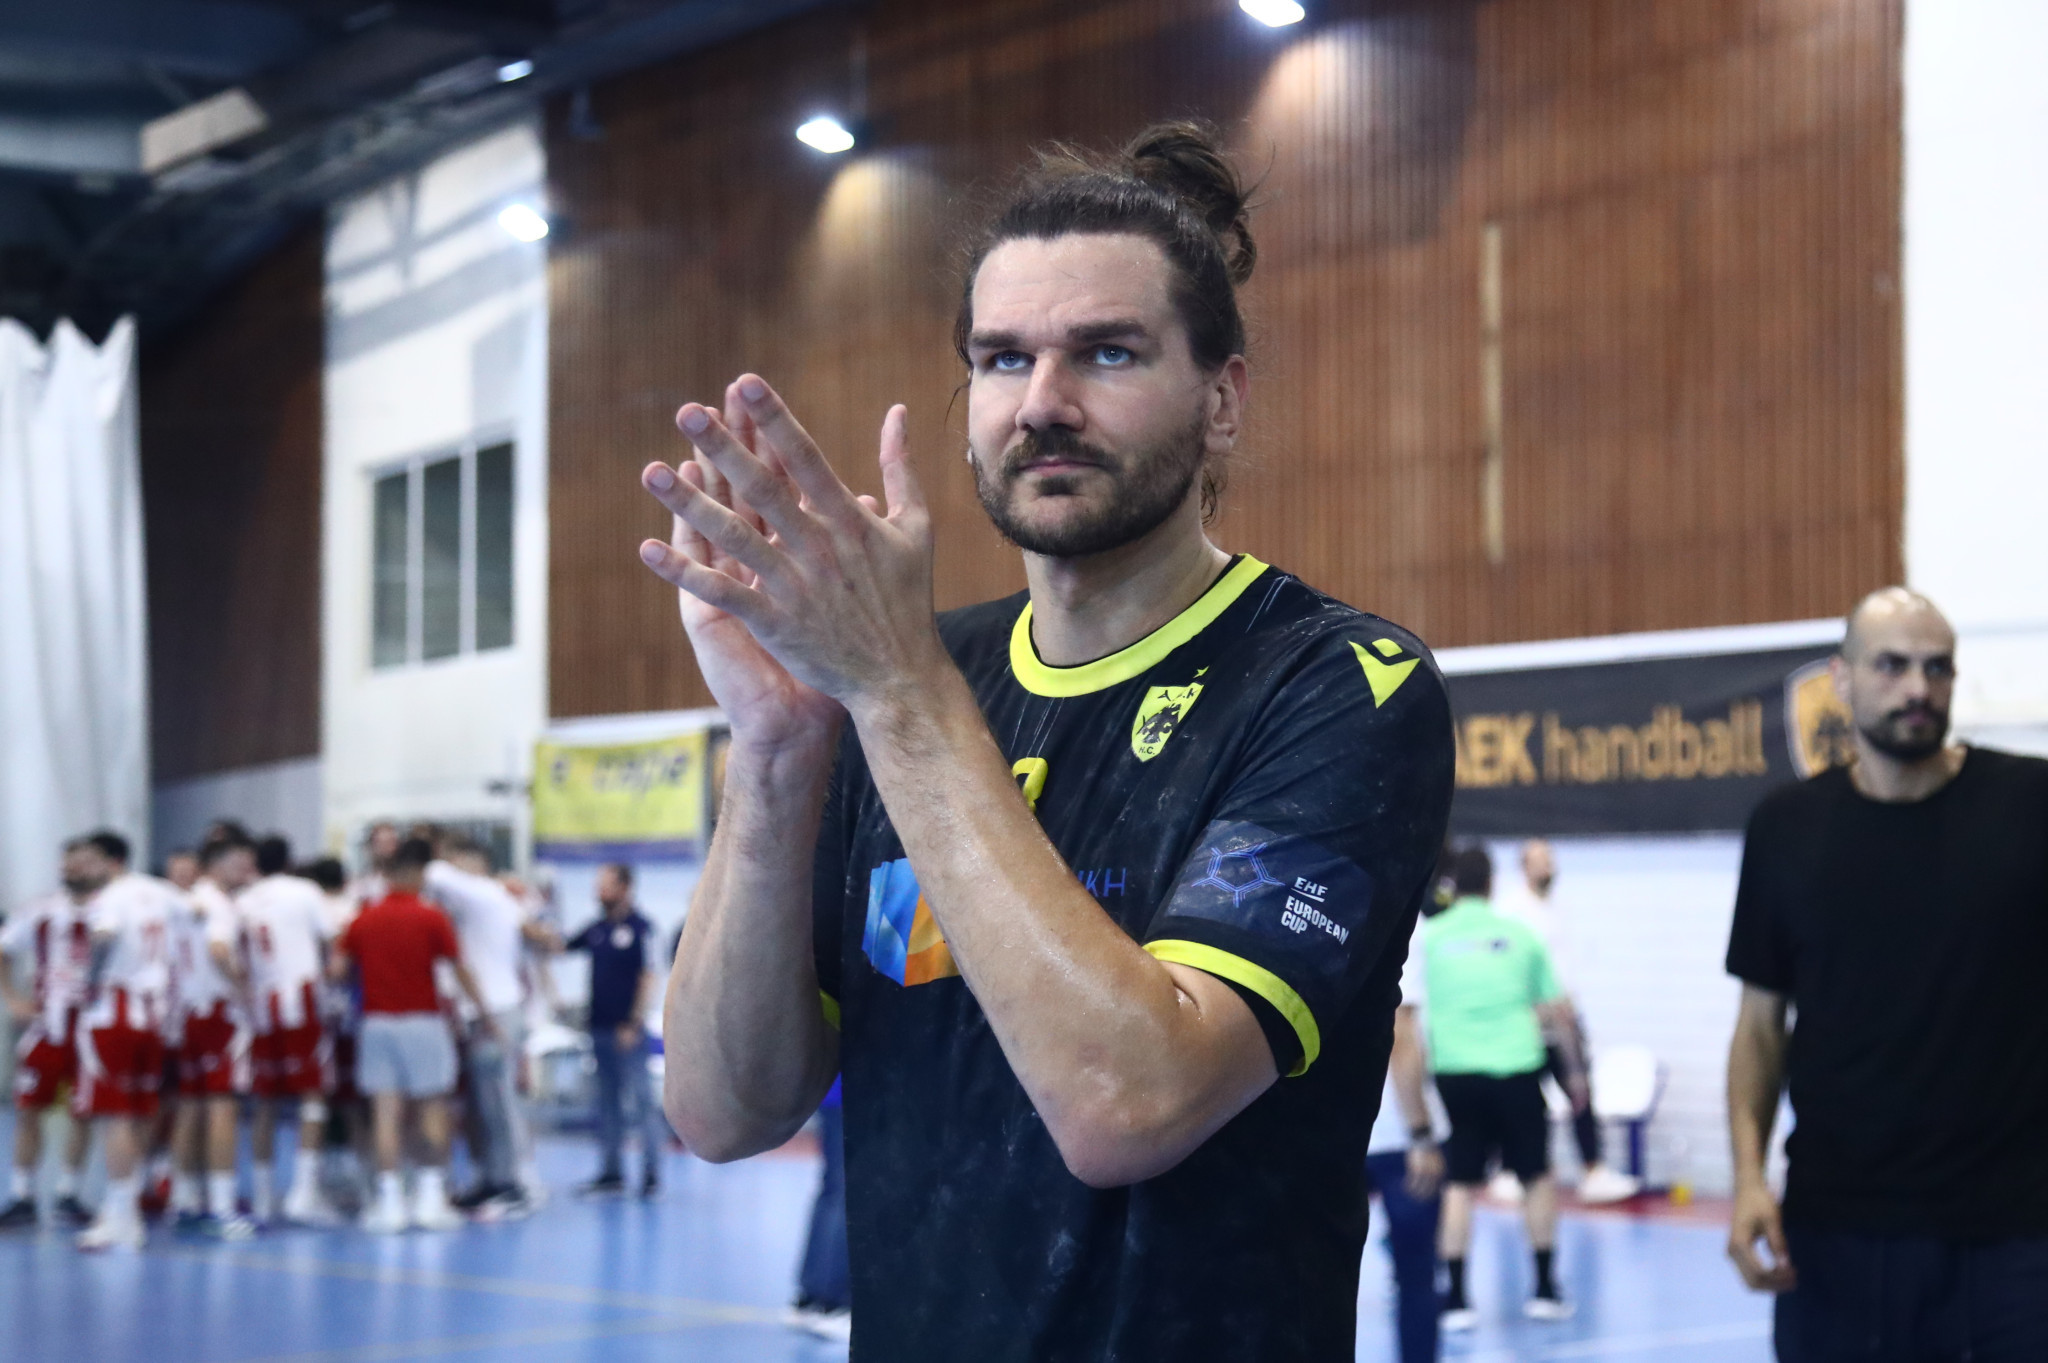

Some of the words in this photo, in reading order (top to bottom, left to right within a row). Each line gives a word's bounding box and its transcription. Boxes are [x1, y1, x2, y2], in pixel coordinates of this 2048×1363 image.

[1542, 700, 1768, 784] handball
[1294, 876, 1328, 896] EHF
[1281, 910, 1308, 934] CUP
[1285, 895, 1349, 945] EUROPEAN
